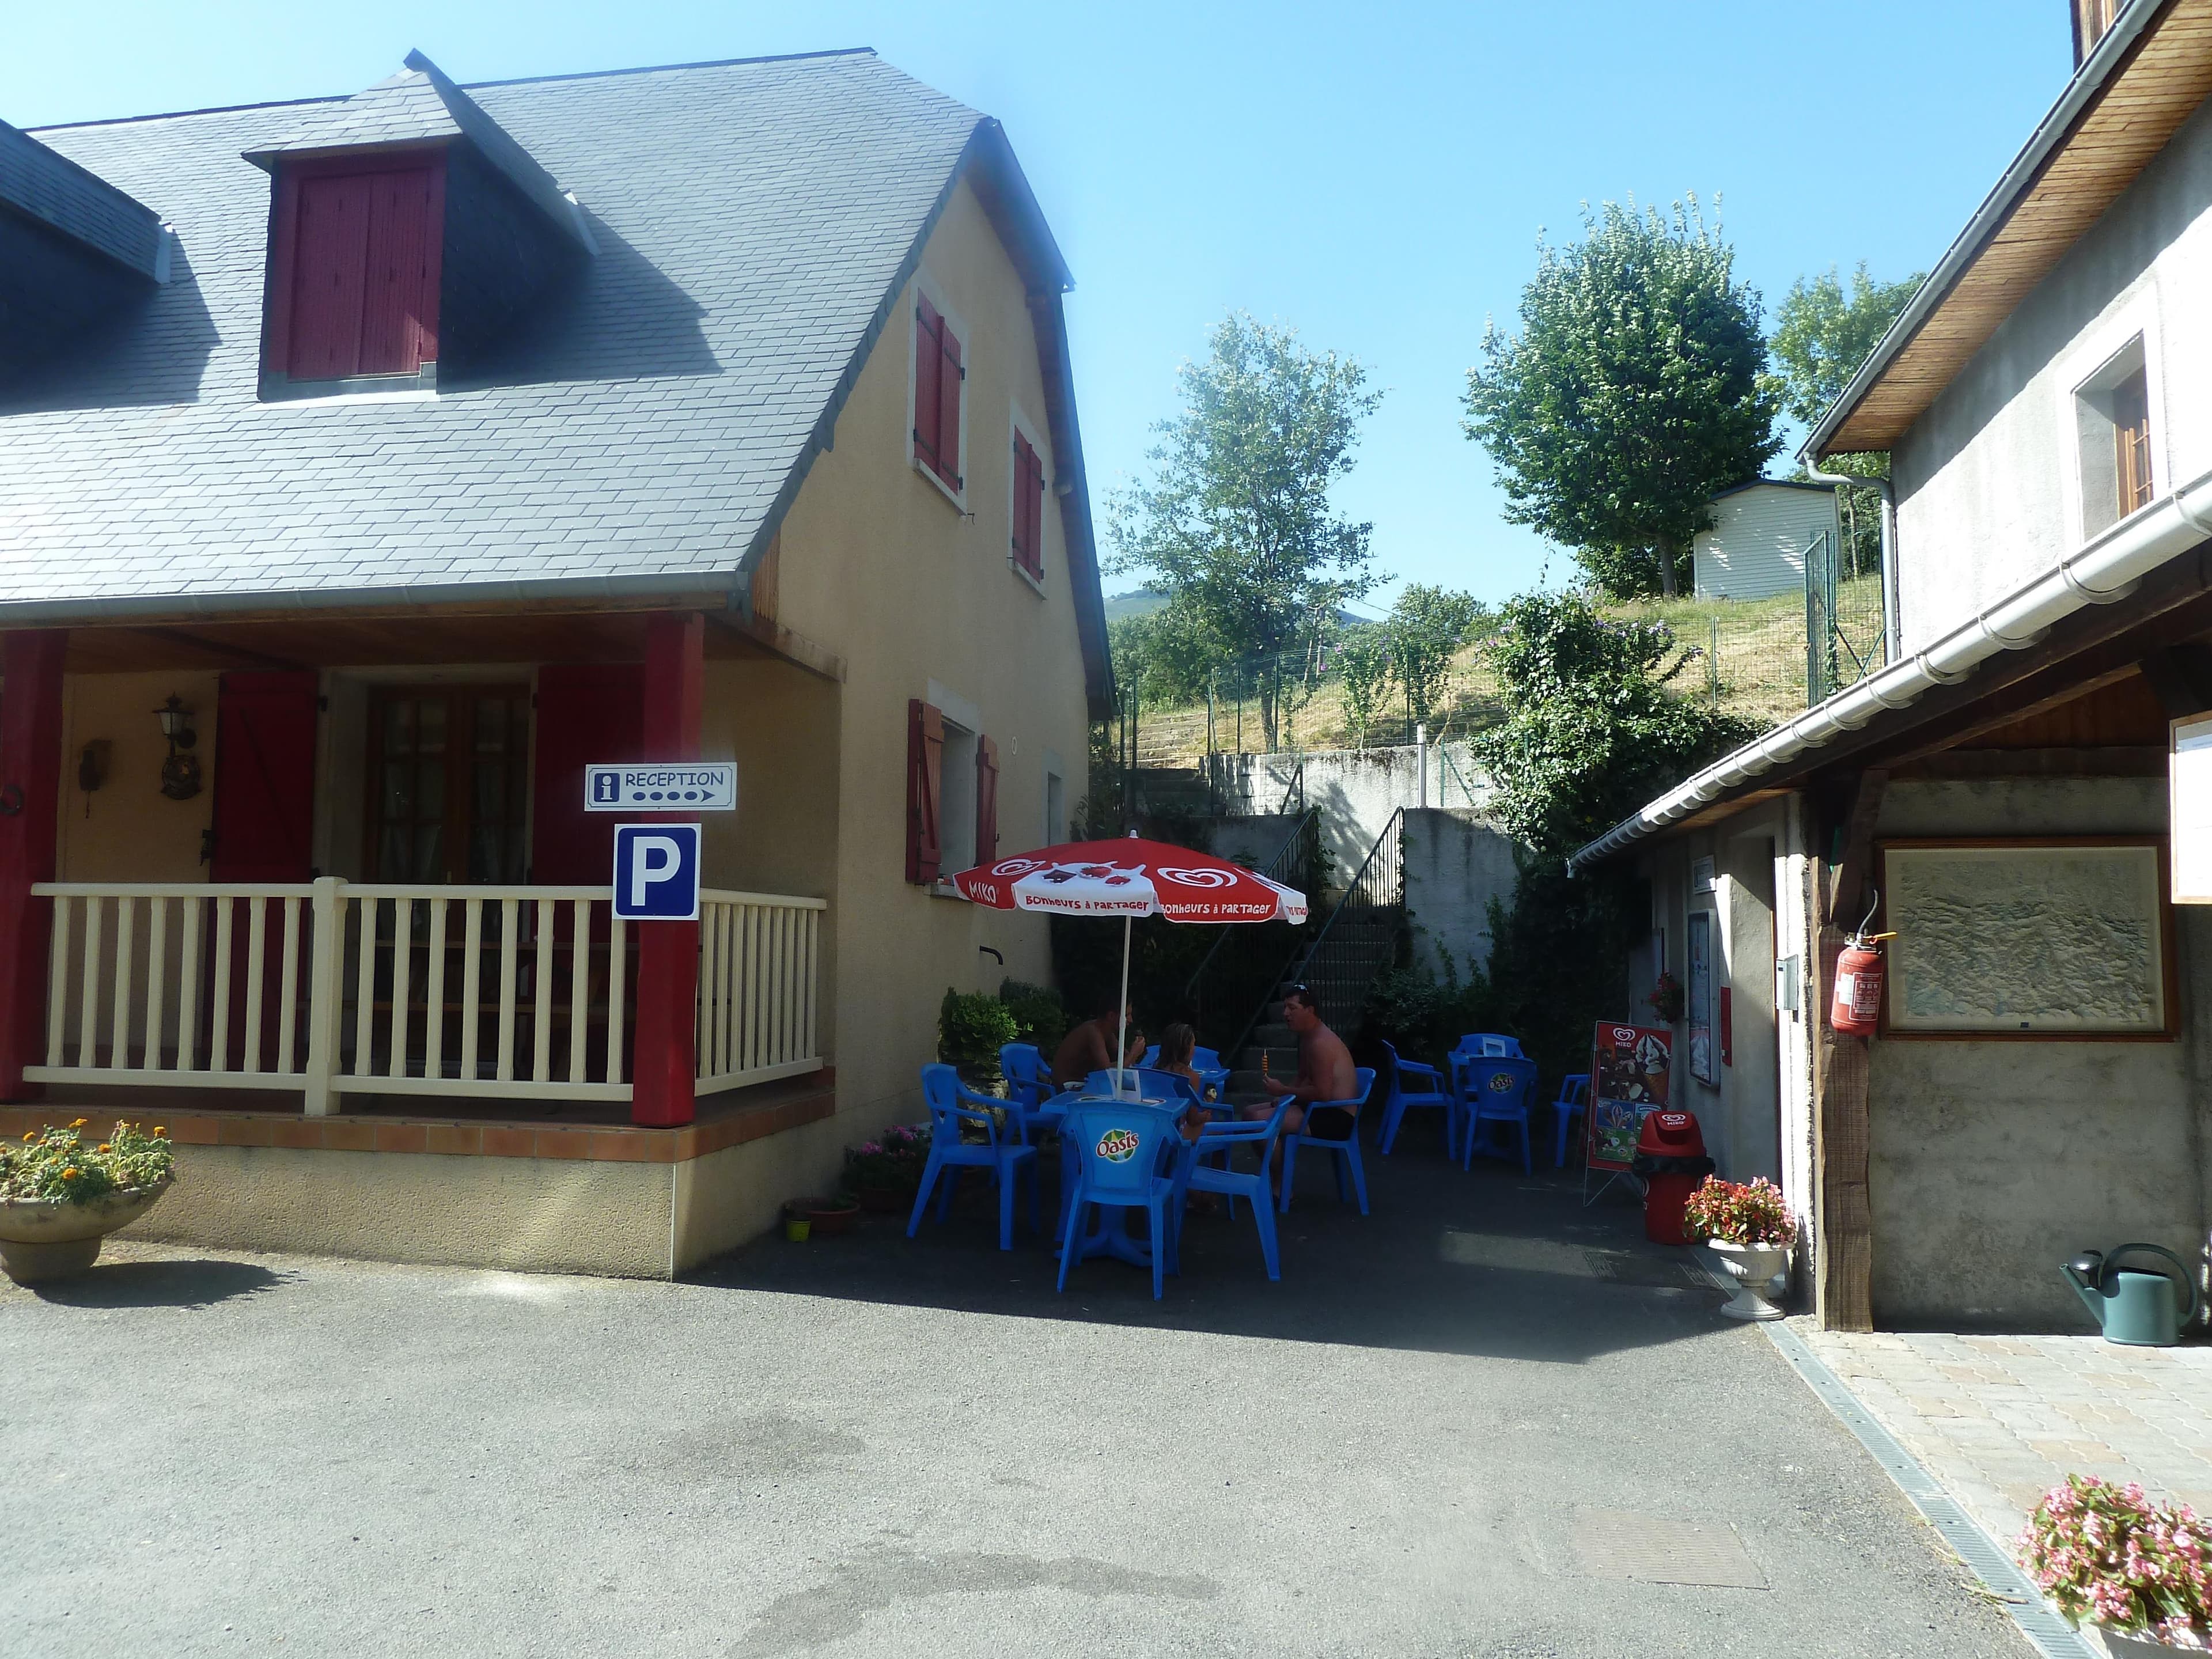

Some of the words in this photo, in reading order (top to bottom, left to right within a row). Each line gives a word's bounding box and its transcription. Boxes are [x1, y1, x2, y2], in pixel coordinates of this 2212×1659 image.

[626, 772, 723, 786] RECEPTION
[631, 836, 681, 906] P
[968, 880, 997, 904] MIKO
[1085, 901, 1090, 909] à
[1213, 904, 1218, 914] à
[1488, 1074, 1514, 1090] Oasis
[1096, 1130, 1139, 1158] Oasis
